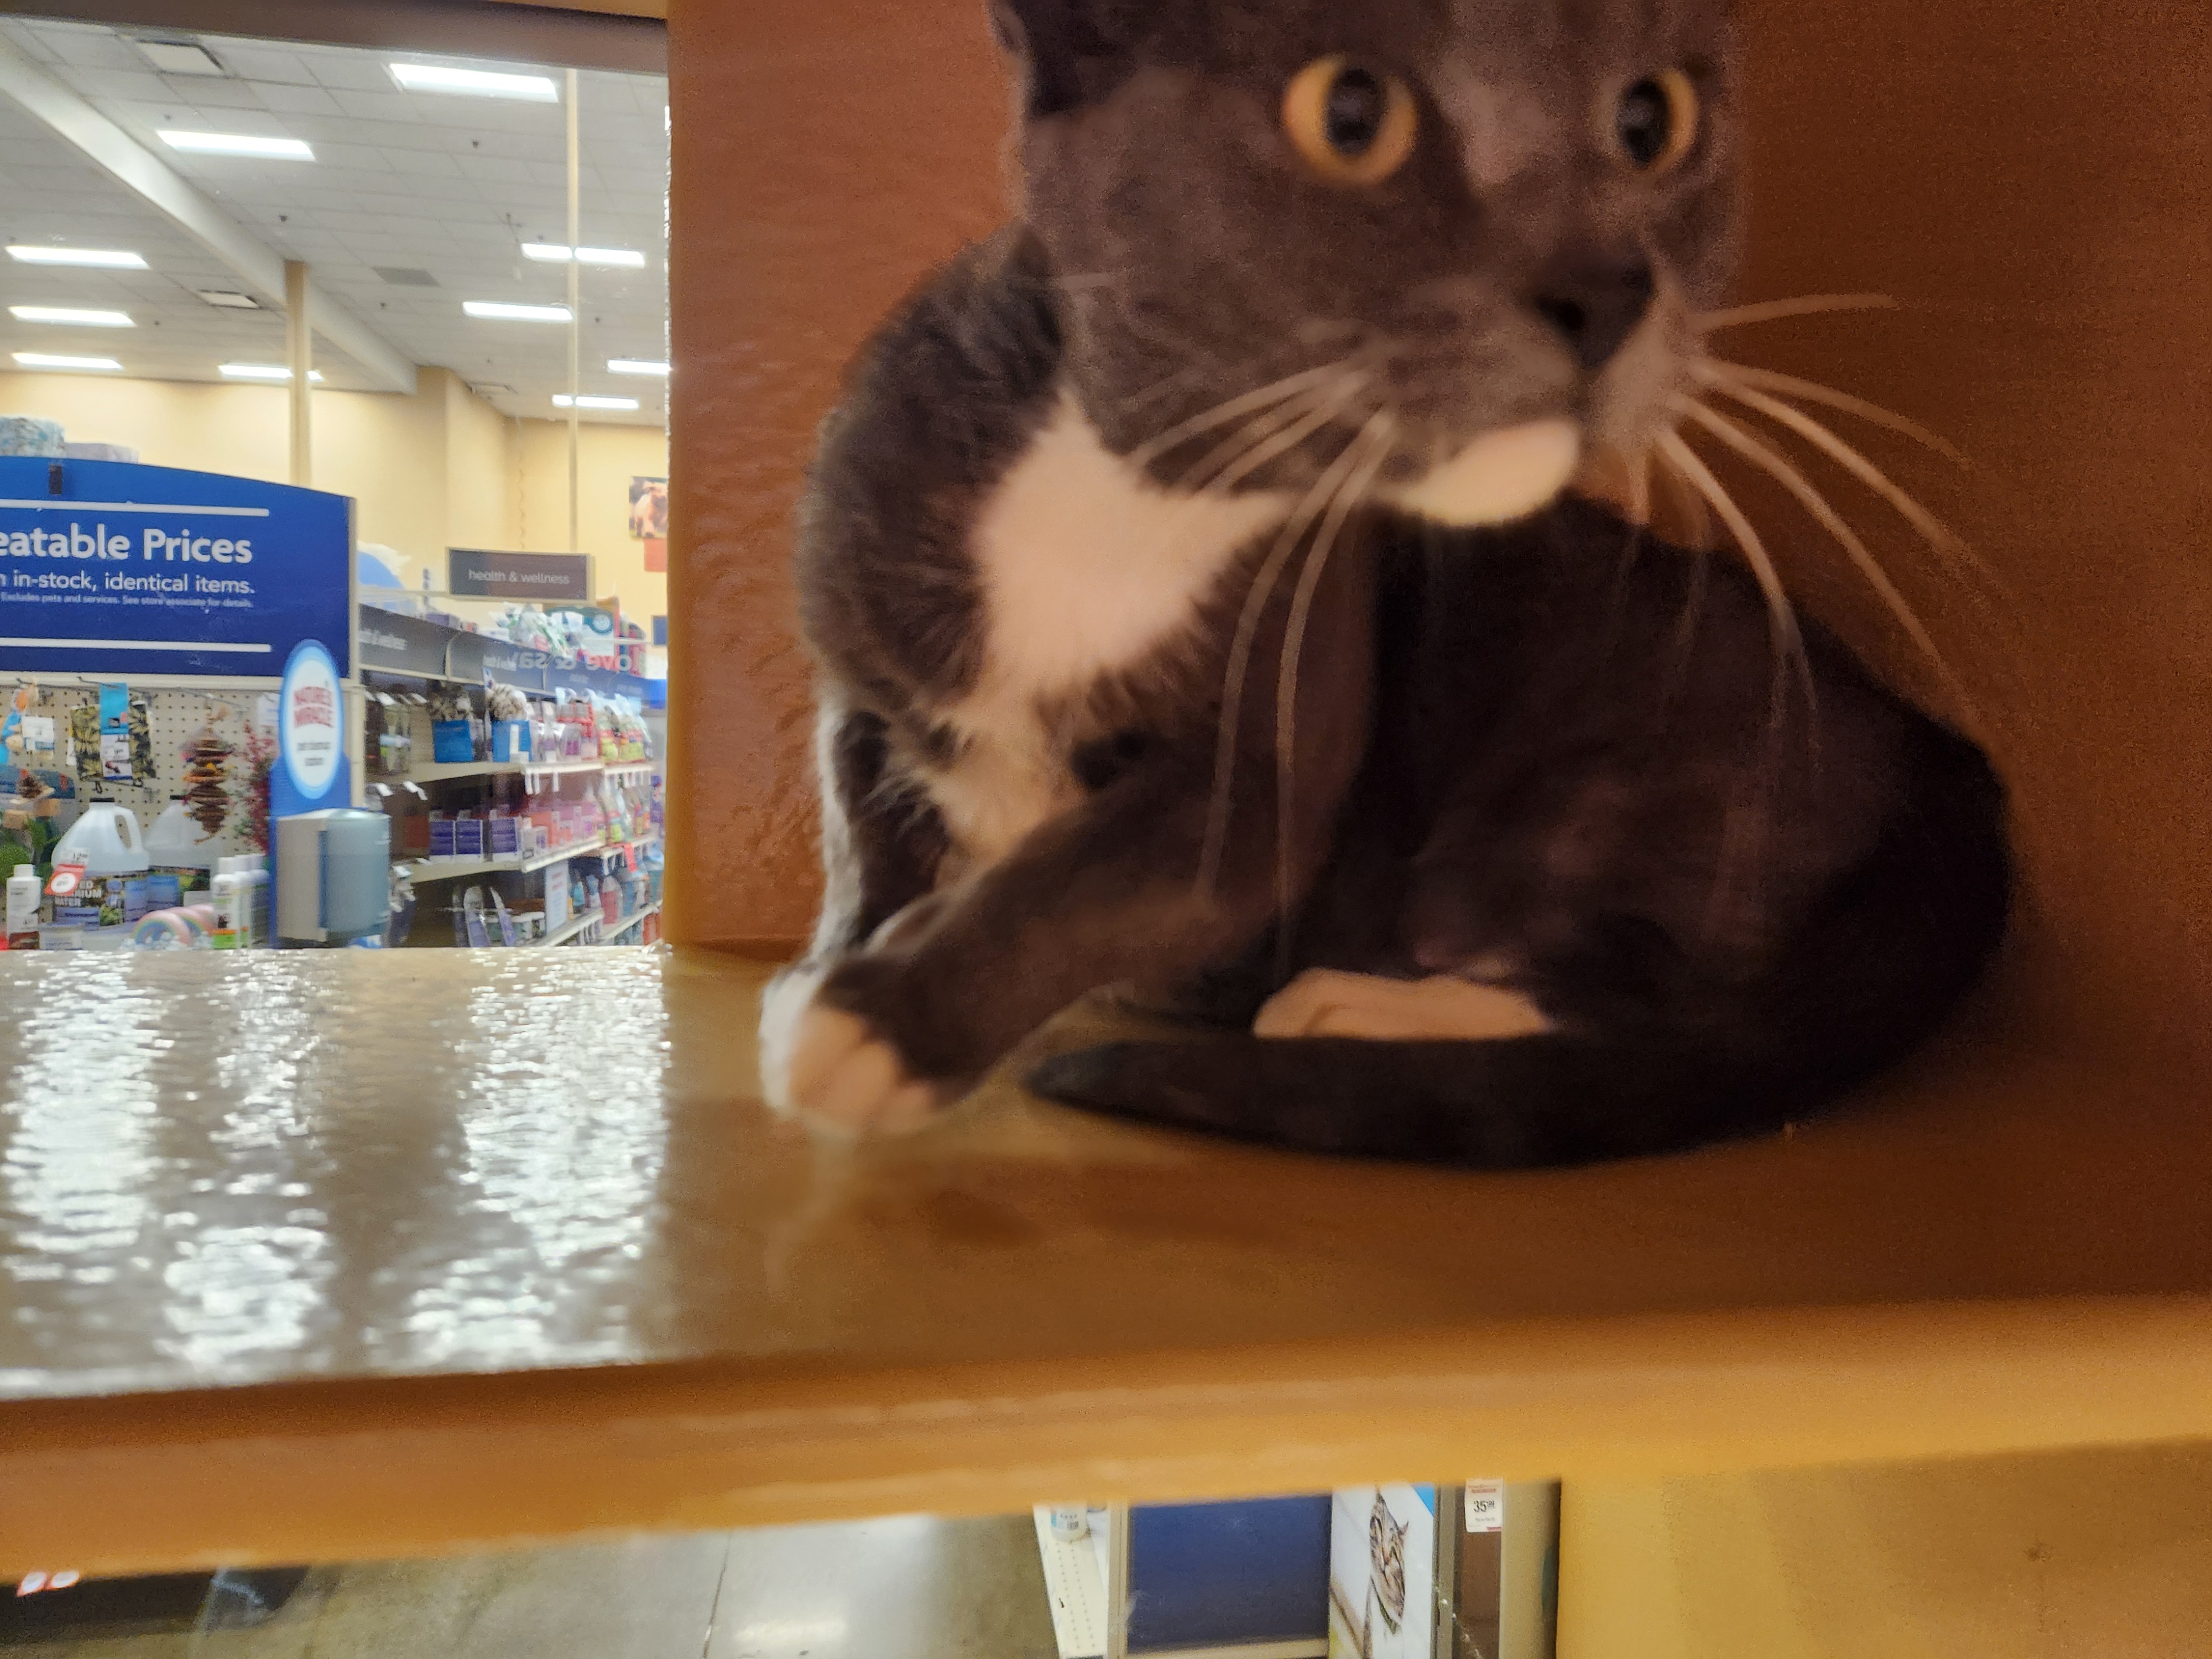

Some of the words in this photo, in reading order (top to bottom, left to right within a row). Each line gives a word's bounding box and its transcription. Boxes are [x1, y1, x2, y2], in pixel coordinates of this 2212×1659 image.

[144, 529, 253, 563] Prices
[13, 569, 96, 592] in-stock,
[105, 571, 188, 592] identical
[196, 575, 255, 593] items.
[469, 568, 506, 582] health
[509, 571, 517, 582] &
[521, 572, 570, 585] wellness
